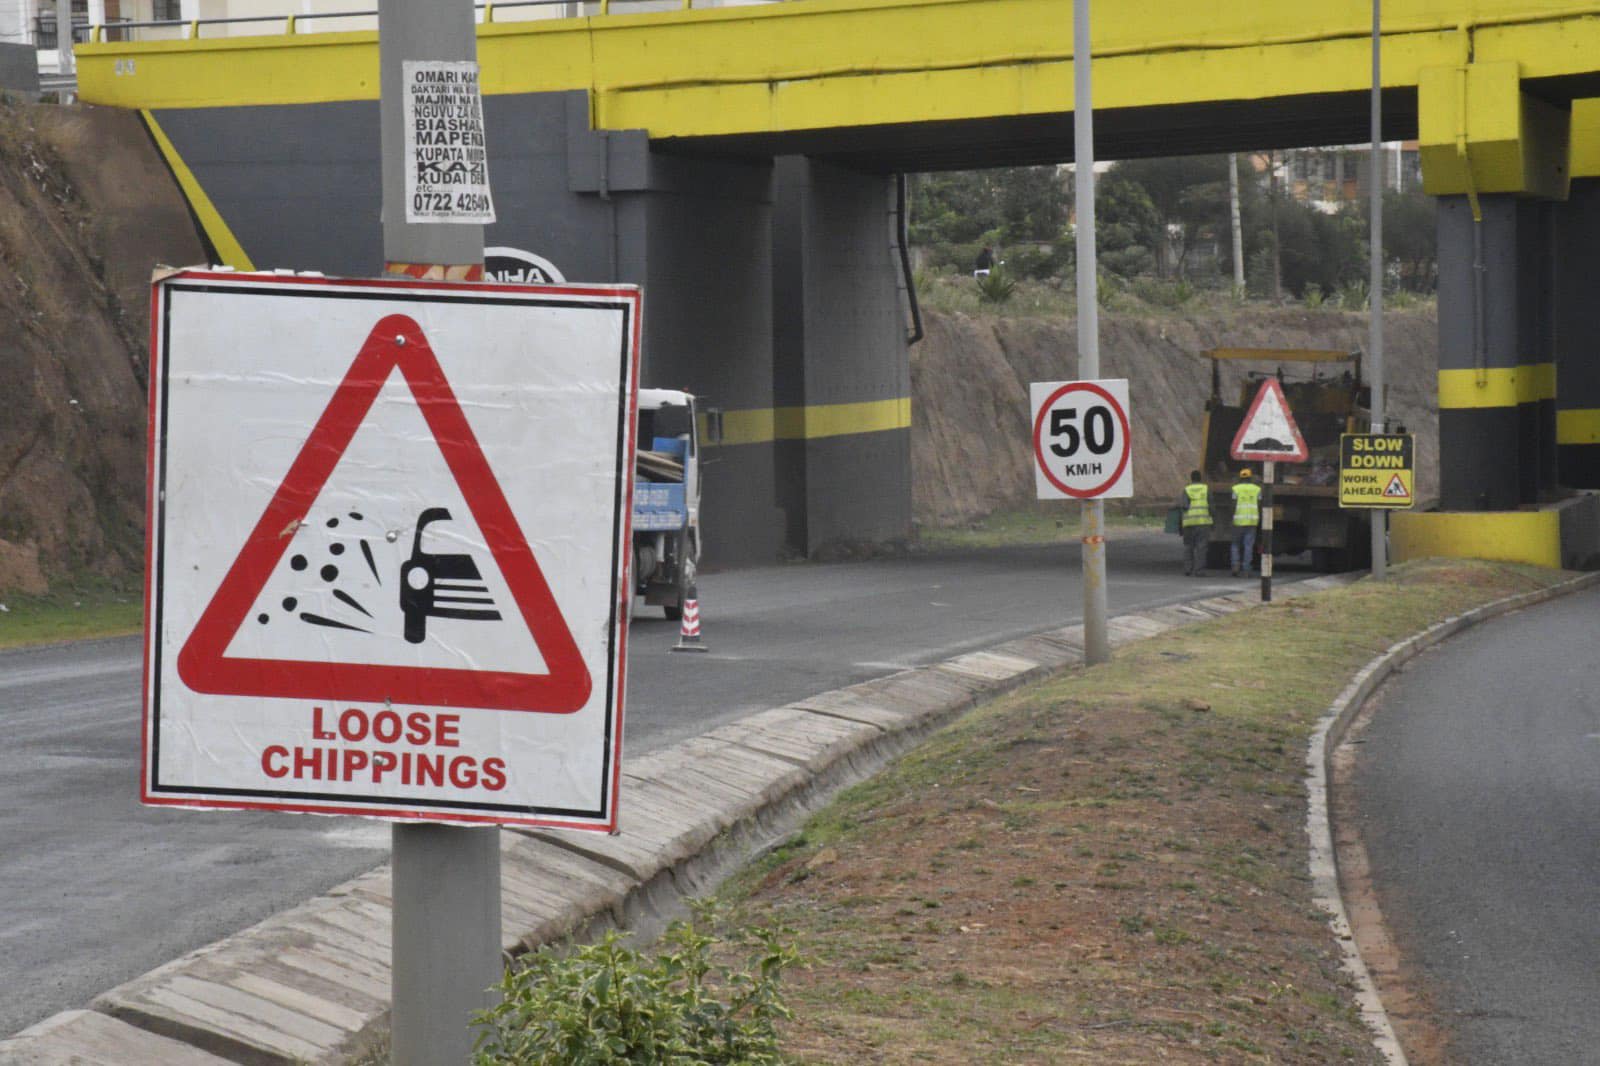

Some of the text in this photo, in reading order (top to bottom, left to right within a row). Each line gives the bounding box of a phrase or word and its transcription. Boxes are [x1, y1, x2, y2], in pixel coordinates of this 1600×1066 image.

[415, 71, 458, 83] OMARI
[411, 85, 450, 94] DAKTARI
[415, 95, 456, 105] MAJINI
[459, 95, 471, 105] NA
[414, 106, 454, 118] NGUVU
[416, 147, 464, 161] KUPATA
[417, 162, 484, 173] KAZI
[417, 172, 467, 185] KUDAI
[413, 193, 452, 211] 0722
[1049, 405, 1115, 458] 50
[1353, 438, 1403, 451] SLOW
[1351, 455, 1403, 468] DOWN
[1065, 463, 1102, 477] KM/H
[1343, 475, 1377, 483] WORK
[1343, 487, 1382, 495] AHEAD
[312, 707, 460, 748] LOOSE
[261, 745, 507, 791] CHIPPINGS
